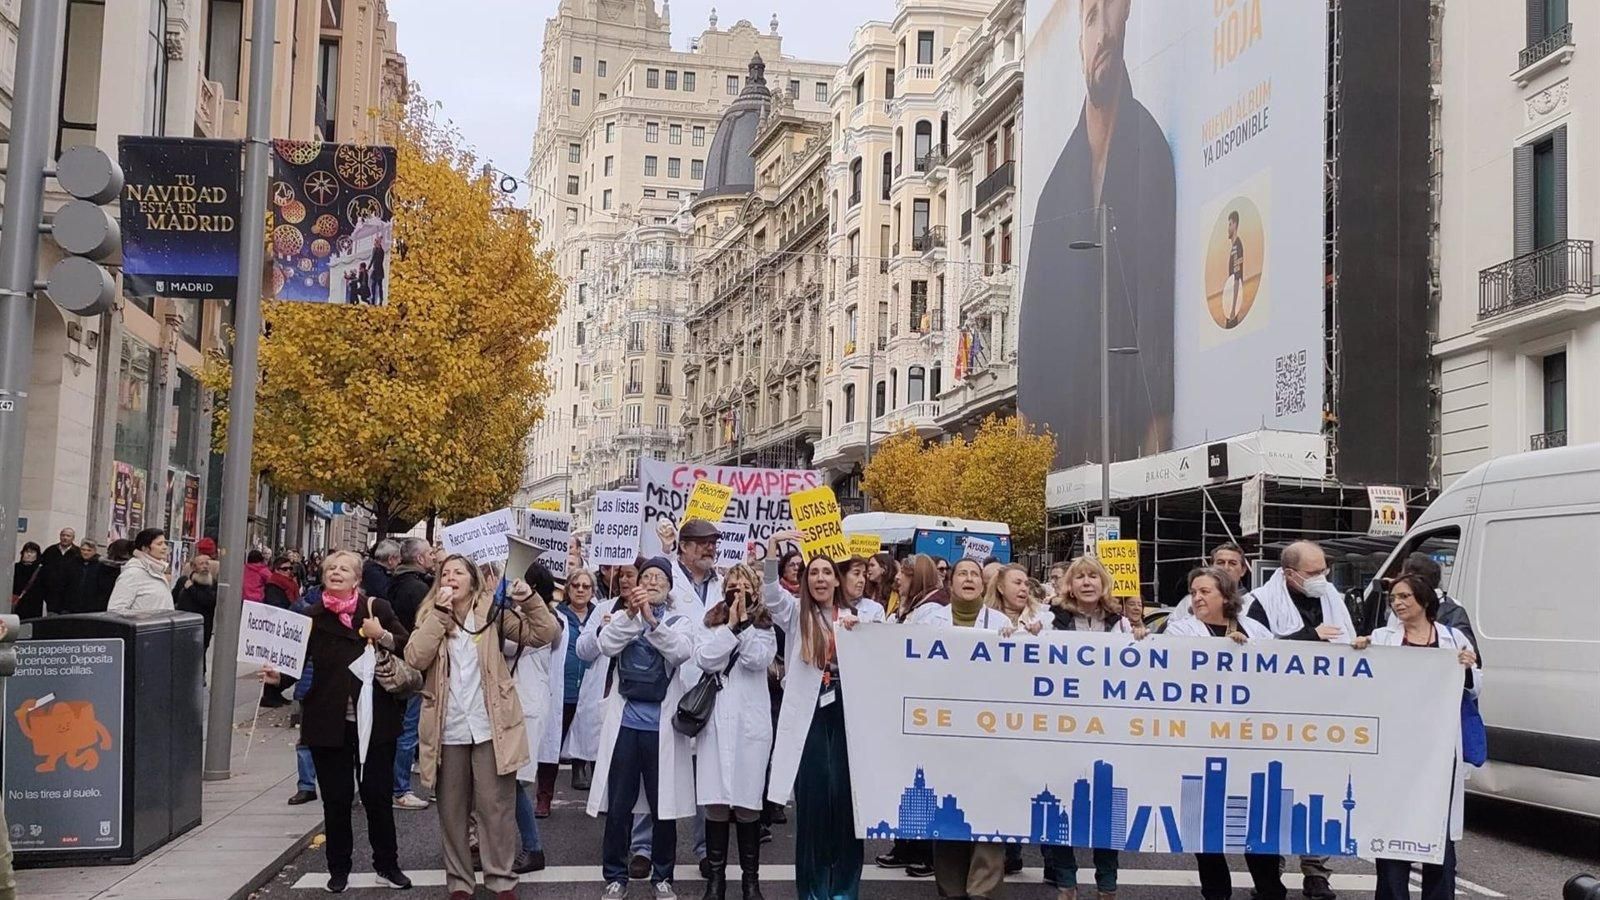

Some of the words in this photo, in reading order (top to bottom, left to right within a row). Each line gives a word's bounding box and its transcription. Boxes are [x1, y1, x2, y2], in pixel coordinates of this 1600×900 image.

[1203, 144, 1214, 168] YA
[1215, 106, 1269, 160] DISPONIBLE
[175, 174, 196, 186] TU
[126, 184, 228, 204] NAVIDAD
[139, 200, 174, 213] ESTÁ
[178, 202, 196, 214] EN
[146, 213, 235, 232] MADRID
[170, 282, 214, 292] MADRID
[596, 497, 613, 513] Las
[615, 498, 640, 514] listas
[699, 501, 723, 514] salud
[724, 497, 750, 519] EN
[795, 501, 827, 521] LISTAS
[827, 499, 837, 514] de
[448, 528, 481, 547] Recortaron
[594, 520, 605, 535] de
[606, 523, 638, 539] espera
[802, 520, 842, 543] ESPERA
[604, 545, 634, 559] matan.
[723, 551, 745, 561] VIDA!
[1101, 547, 1126, 559] LISTAS
[1128, 547, 1137, 557] de
[1112, 580, 1137, 591] ATAN
[38, 645, 80, 656] papelera
[82, 644, 107, 653] tiene
[245, 639, 255, 656] Sus
[24, 656, 68, 666] cenicero.
[70, 654, 113, 665] Deposita
[905, 638, 949, 660] LA
[970, 641, 1169, 669] ATENCIÓN
[1191, 649, 1374, 679] PRIMARIA
[44, 666, 58, 675] las
[59, 665, 94, 675] colillas.
[1033, 676, 1080, 699] DE
[1102, 679, 1250, 705] MADRID
[912, 708, 952, 727] SE
[976, 711, 1105, 735] QUEDA
[1129, 718, 1187, 738] SIN
[1210, 718, 1371, 745] MÉDICOS
[9, 790, 23, 800] No
[25, 790, 39, 799] las
[40, 790, 61, 799] tires
[62, 789, 72, 798] al
[72, 788, 102, 798] suelo.
